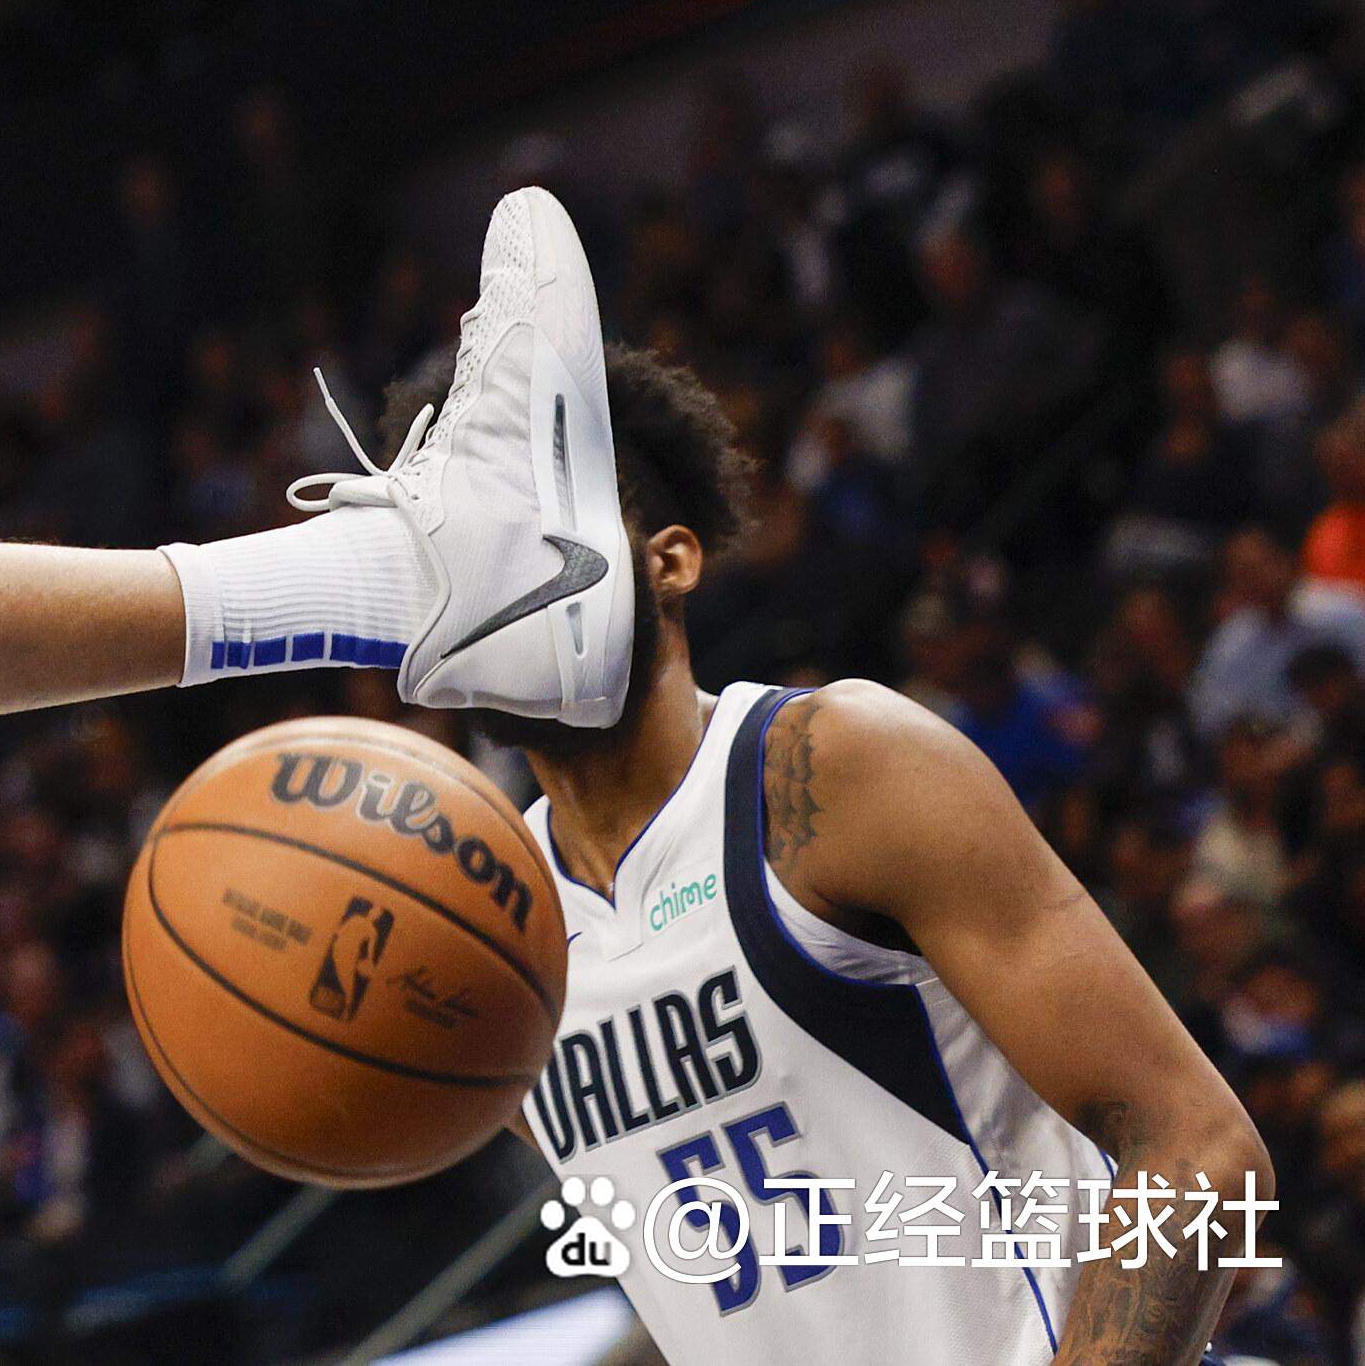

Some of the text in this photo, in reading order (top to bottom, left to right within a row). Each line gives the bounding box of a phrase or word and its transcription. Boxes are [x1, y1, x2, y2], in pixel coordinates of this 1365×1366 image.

[270, 752, 533, 933] Wilson
[649, 873, 718, 932] chime
[531, 964, 762, 1163] DALLAS
[655, 1100, 846, 1318] 55
